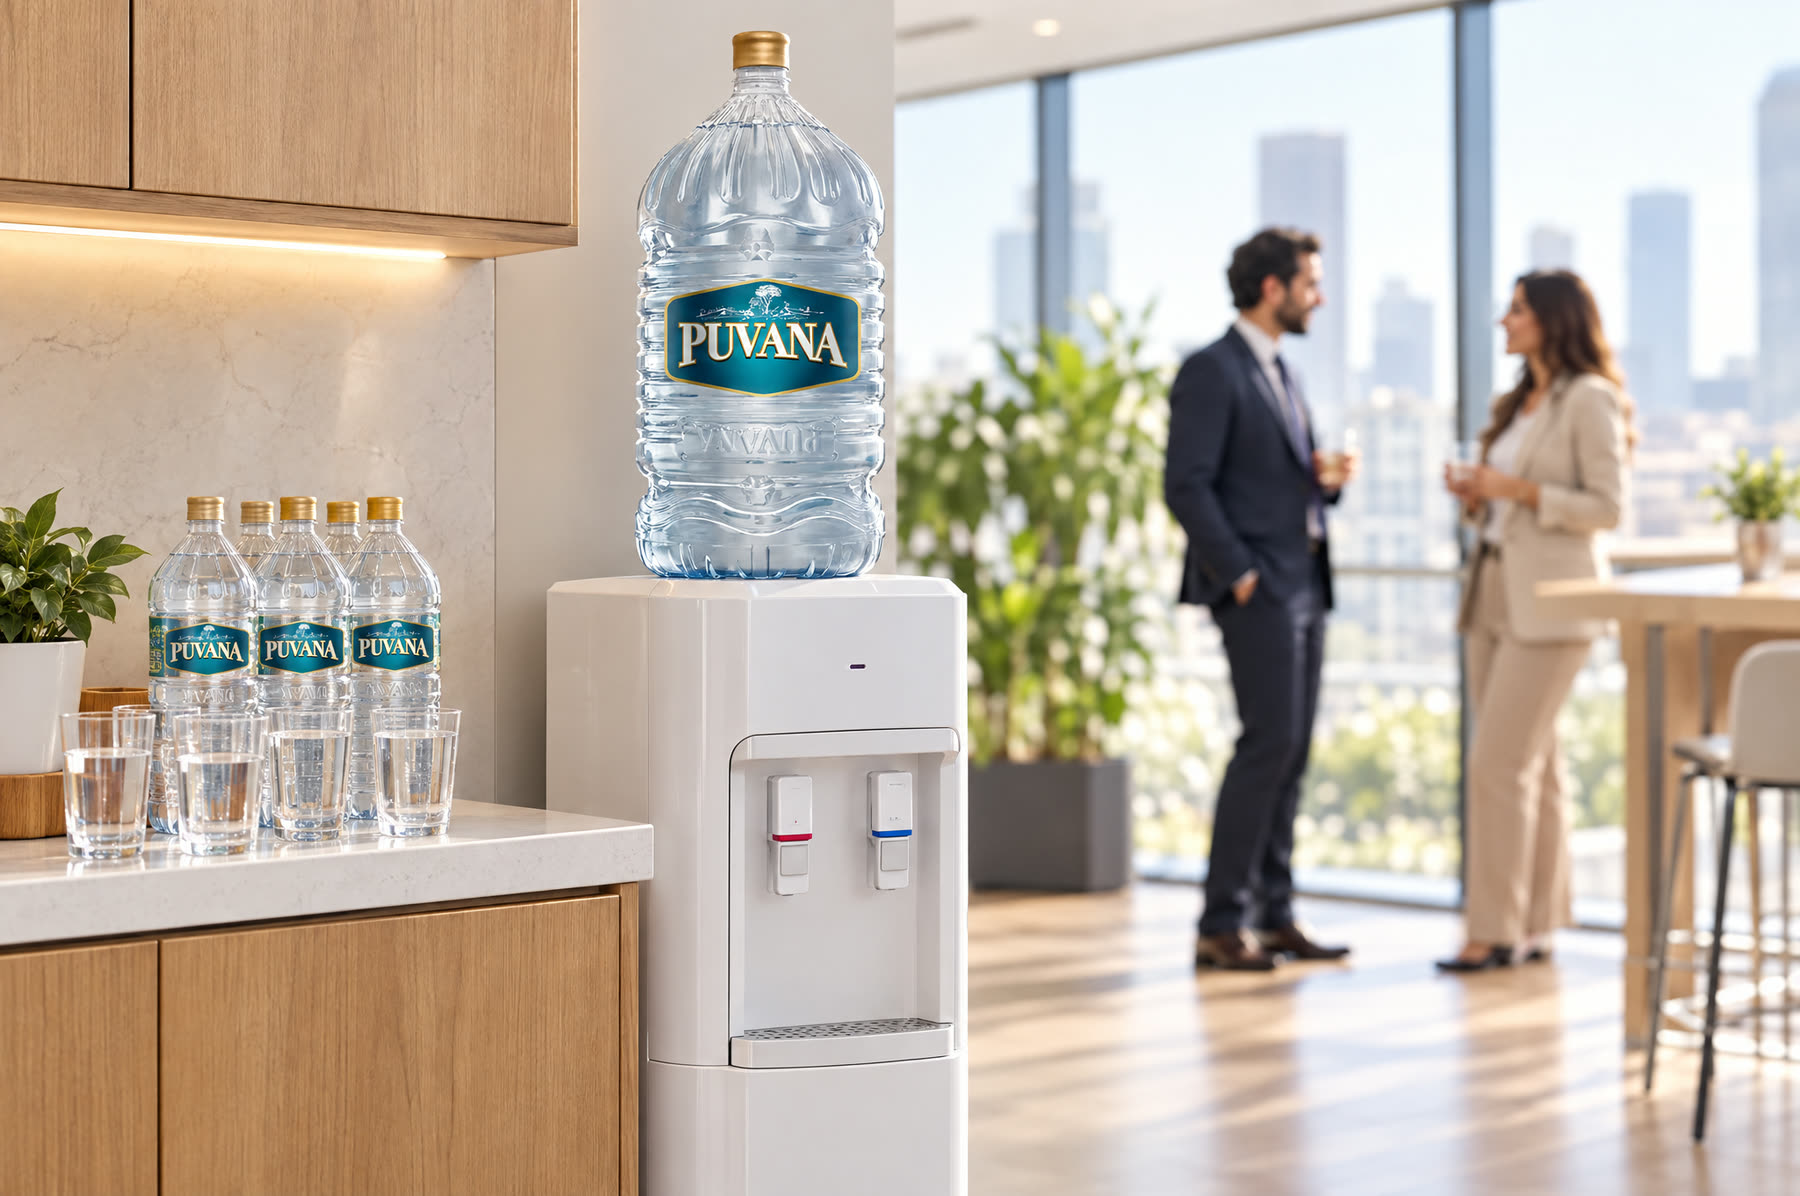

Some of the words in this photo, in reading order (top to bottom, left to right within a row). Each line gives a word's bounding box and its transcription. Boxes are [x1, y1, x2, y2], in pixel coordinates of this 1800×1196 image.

[678, 321, 848, 368] PUVANA
[170, 641, 245, 663] PUVANA
[265, 640, 339, 661] PUVANA
[358, 638, 430, 659] PUVANA
